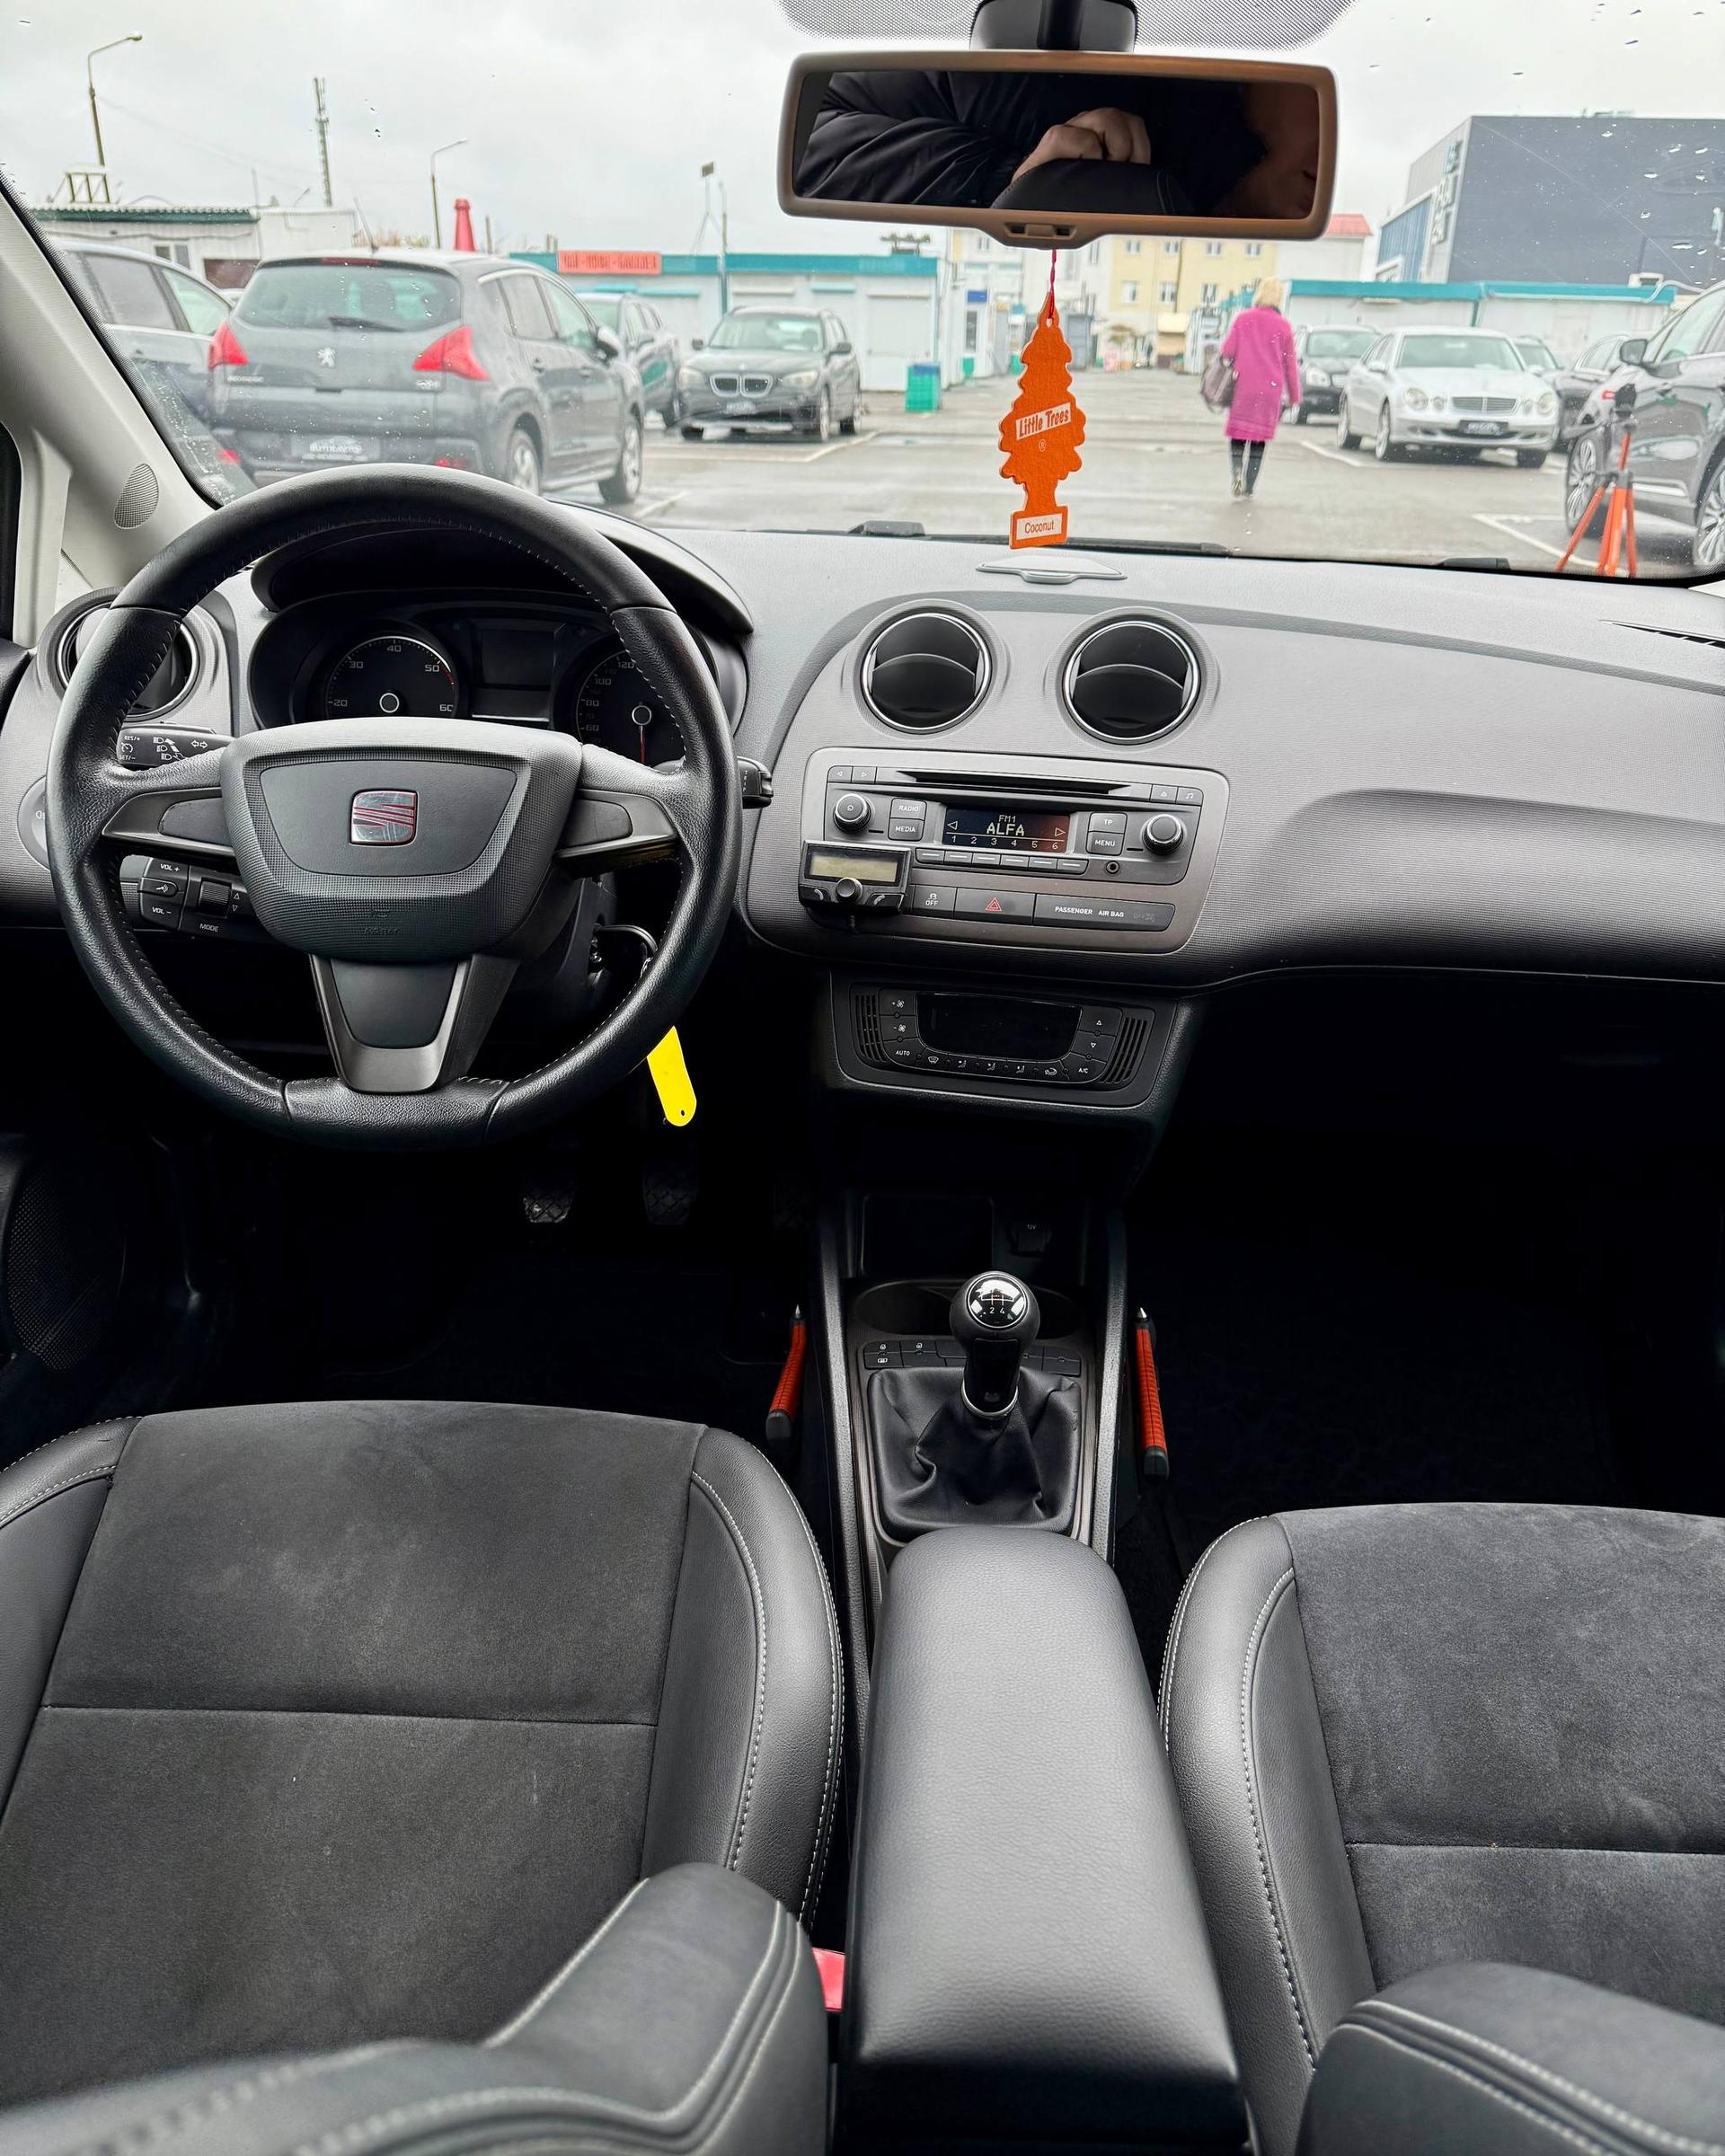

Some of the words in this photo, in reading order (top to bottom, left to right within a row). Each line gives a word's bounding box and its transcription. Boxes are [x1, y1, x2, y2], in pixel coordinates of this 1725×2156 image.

[1019, 415, 1043, 437] Little
[1045, 408, 1069, 429] Trees
[1024, 521, 1055, 534] Coconut
[386, 645, 402, 653] 40
[349, 661, 364, 669] 30
[424, 665, 440, 673] 50
[618, 661, 635, 669] 120
[594, 677, 613, 686] 100
[333, 699, 349, 707] 20
[585, 699, 600, 707] 80
[585, 724, 600, 732] 60
[998, 814, 1016, 824] FM1
[986, 822, 1025, 836] ALFA
[951, 835, 957, 844] 1
[970, 836, 977, 844] 2
[991, 837, 997, 845] 3
[1011, 839, 1017, 847] 4
[1031, 840, 1038, 849] 5
[1052, 842, 1058, 850] 6
[160, 863, 172, 871] VOL
[152, 906, 164, 915] VOL
[1055, 906, 1093, 915] PASSENGER
[199, 923, 219, 933] MODE
